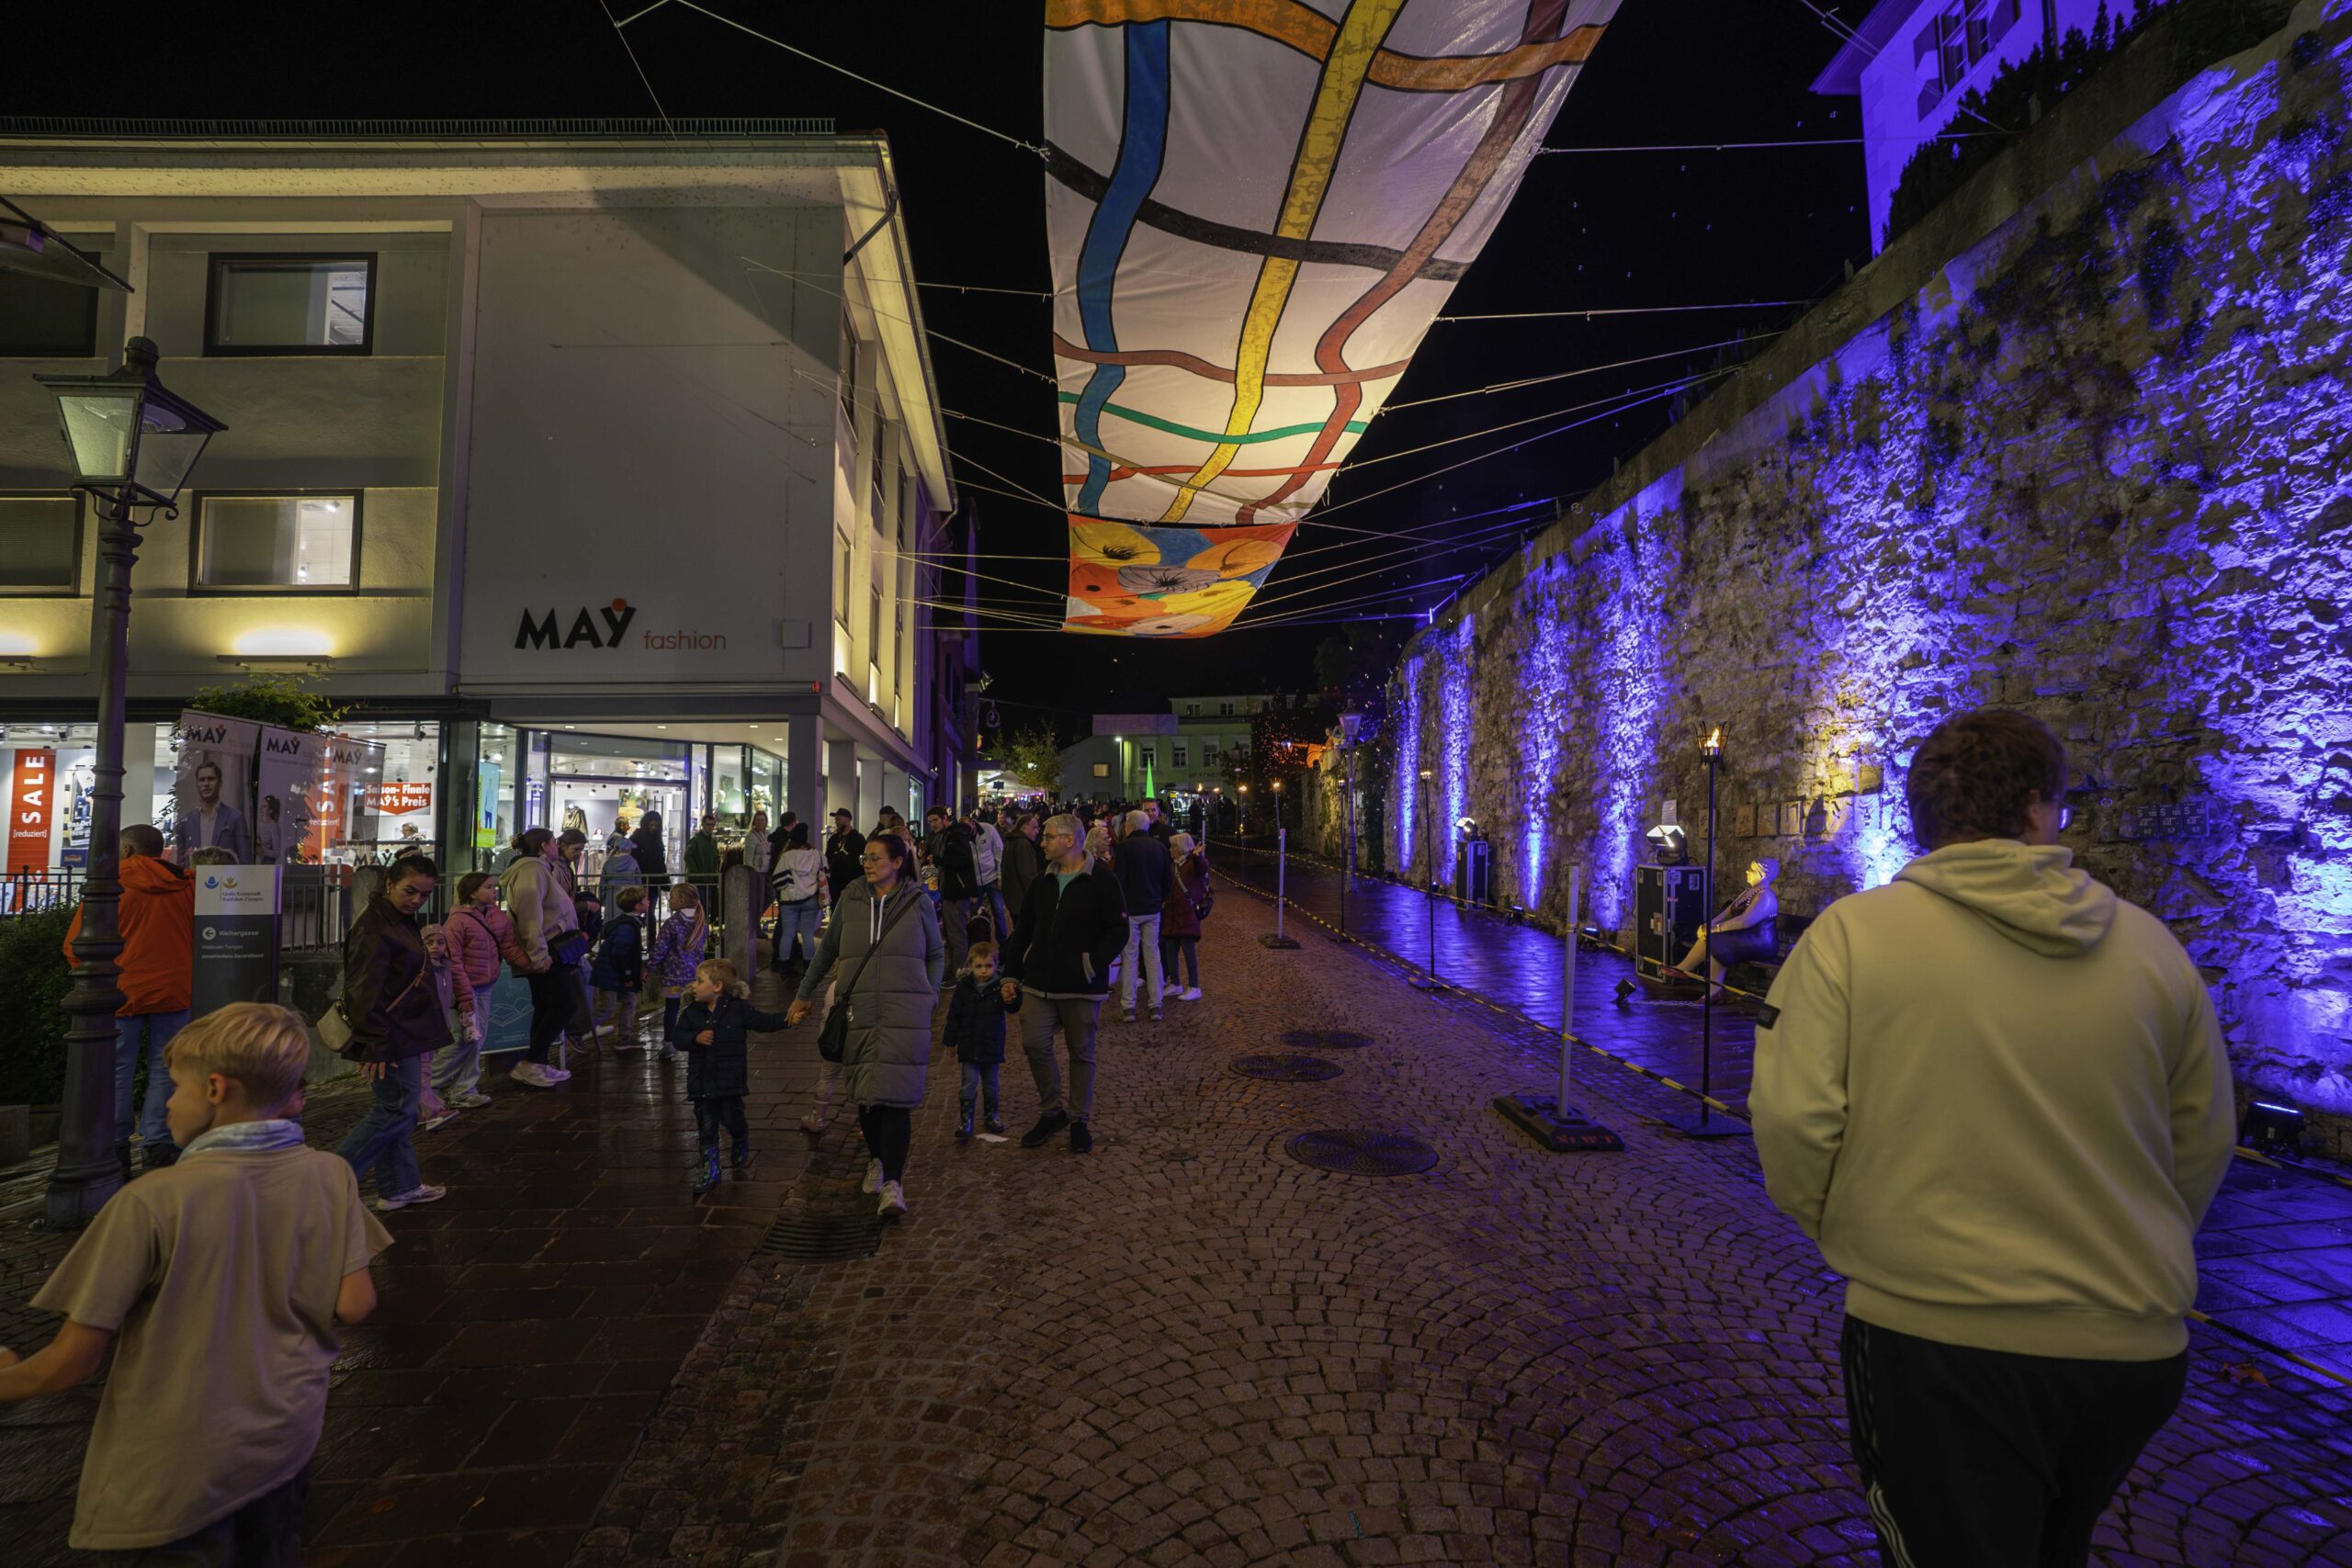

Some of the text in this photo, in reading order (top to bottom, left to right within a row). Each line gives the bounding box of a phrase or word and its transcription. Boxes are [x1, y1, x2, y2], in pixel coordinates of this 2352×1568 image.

[514, 598, 727, 650] MAY fashion
[186, 723, 227, 744] MAY
[266, 736, 301, 754] MAY
[334, 748, 363, 765] MAY
[22, 756, 45, 824] SALE
[367, 784, 431, 795] Saison- Finale
[401, 795, 427, 807] Preis
[354, 848, 393, 866] MAY
